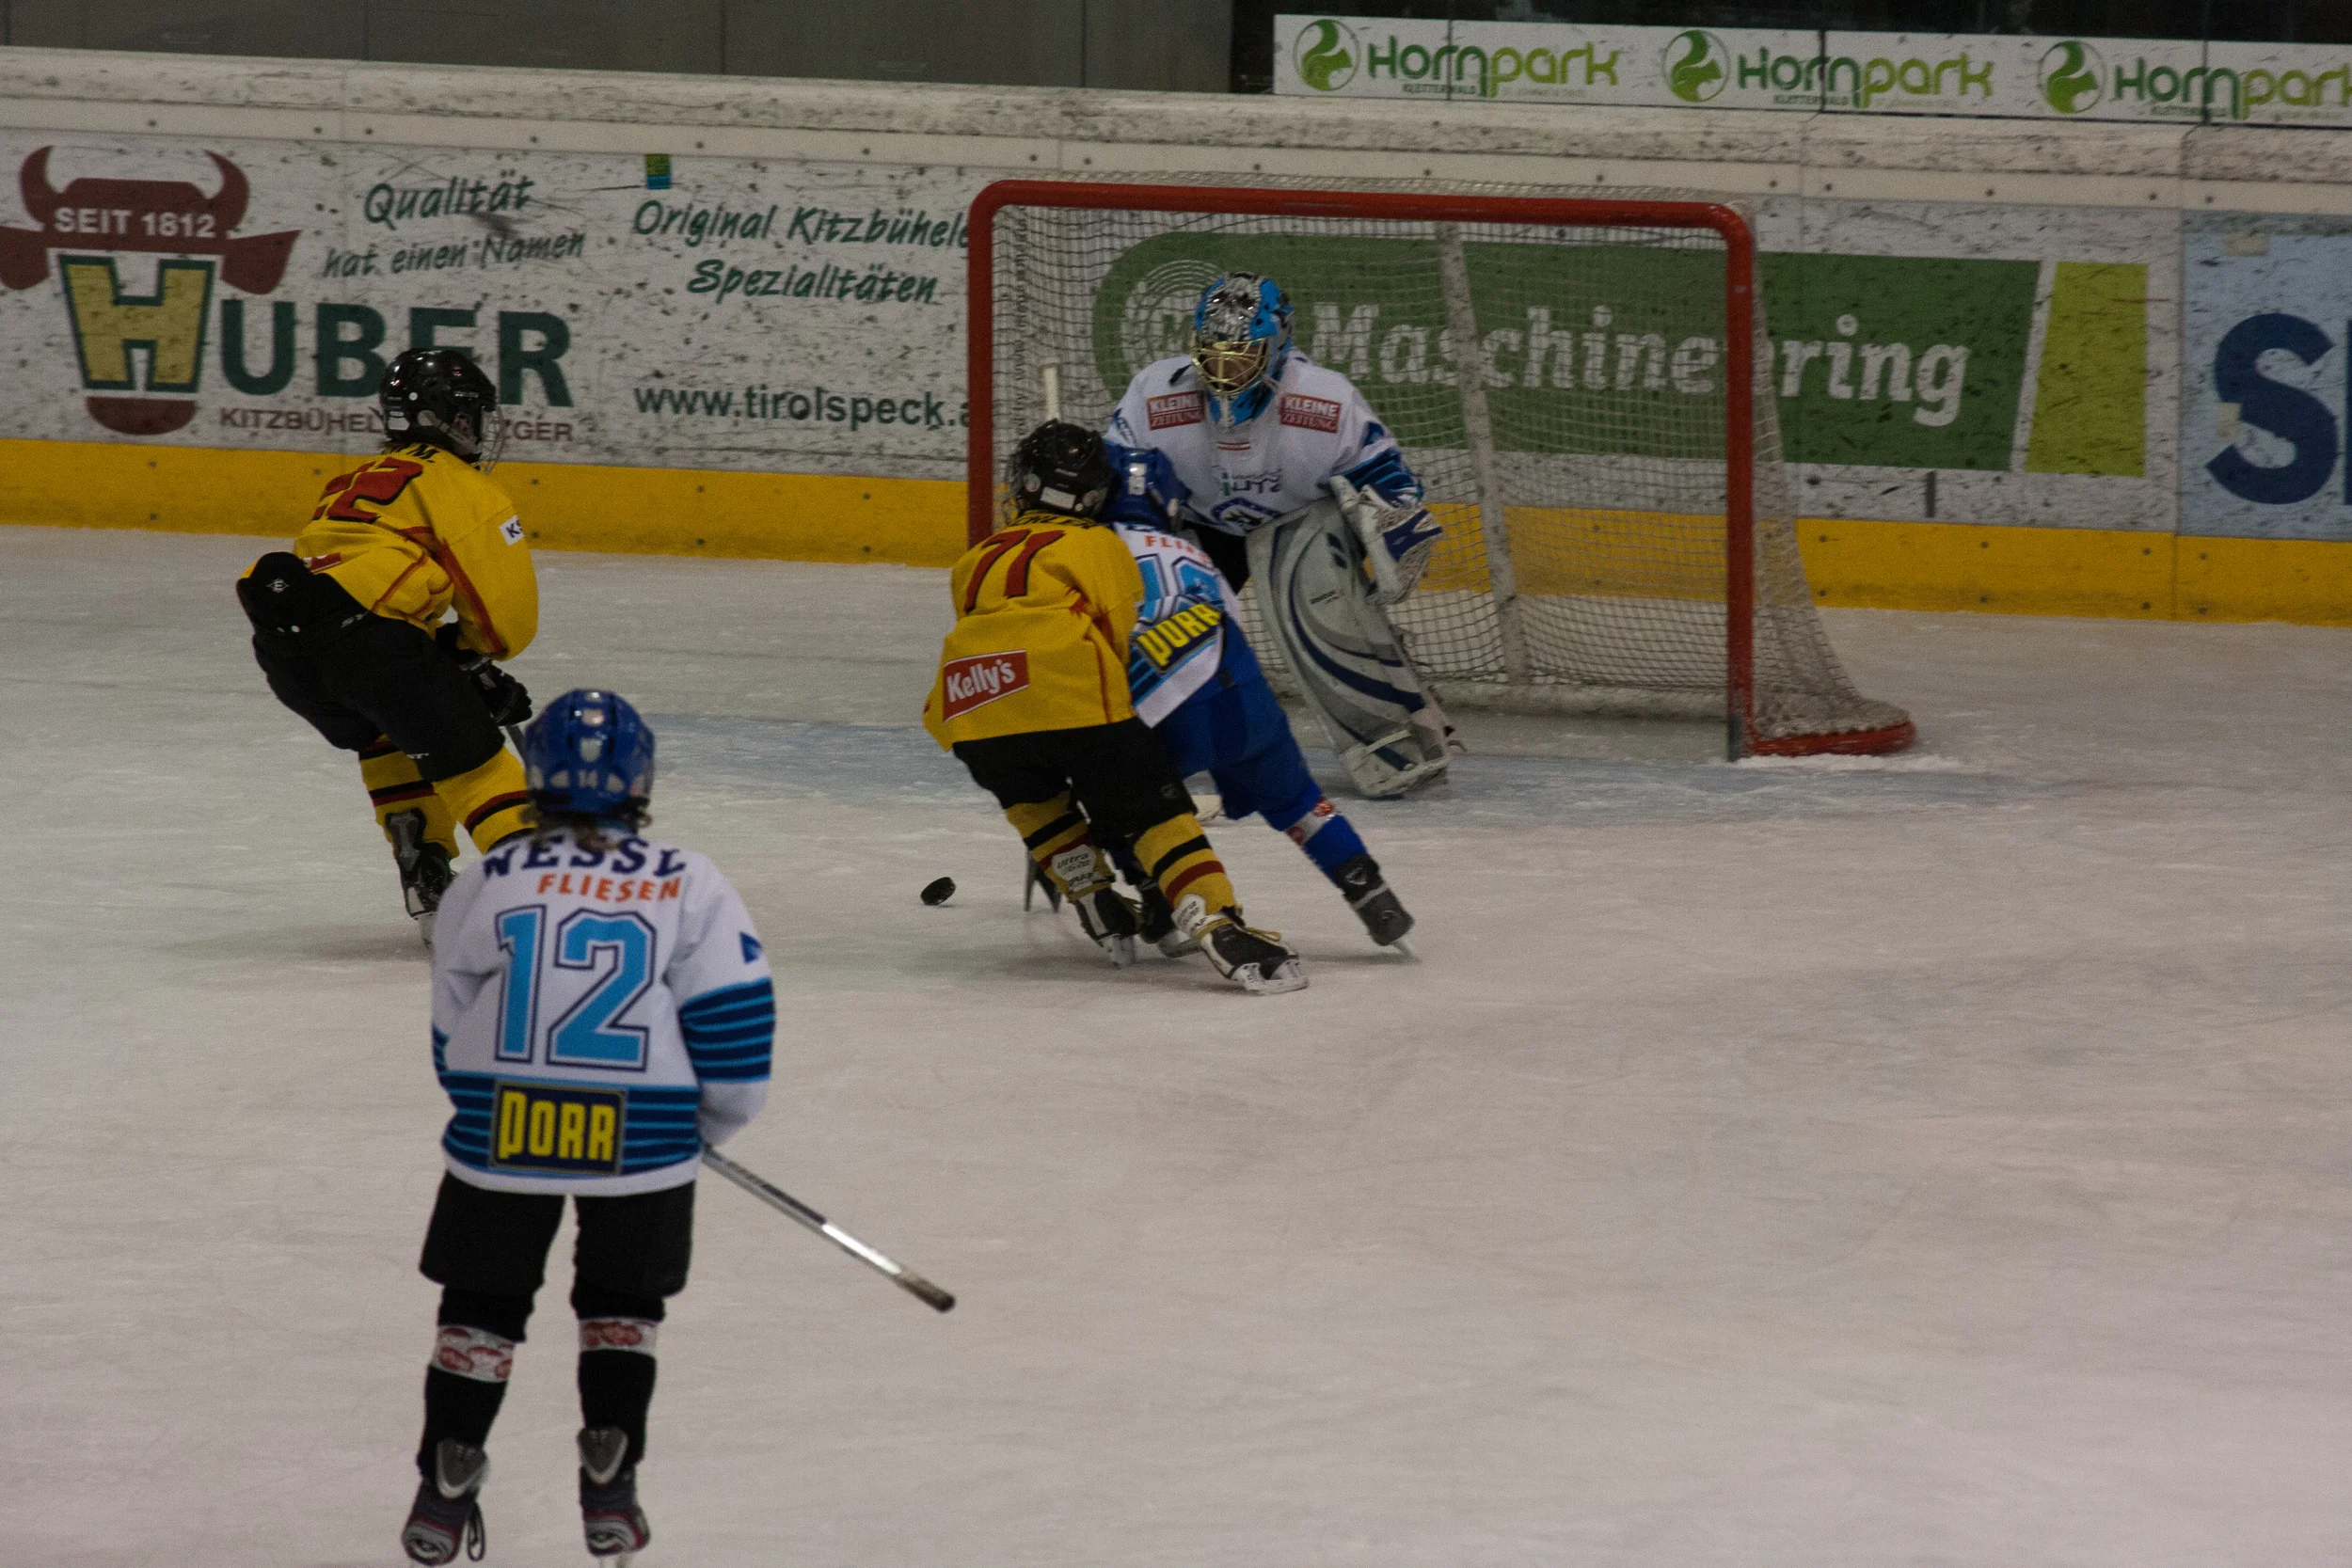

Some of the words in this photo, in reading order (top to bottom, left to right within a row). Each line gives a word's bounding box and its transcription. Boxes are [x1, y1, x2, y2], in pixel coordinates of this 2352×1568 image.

[1368, 35, 1618, 98] Hornpark
[1738, 46, 1994, 109] Hornpark
[363, 167, 536, 224] Qualität
[55, 206, 132, 235] SEIT
[142, 212, 218, 239] 1812
[633, 199, 777, 247] Original
[787, 206, 970, 249] Kitzbühele
[324, 247, 375, 279] hat
[391, 245, 467, 276] einen
[478, 231, 587, 266] Namen
[687, 259, 939, 304] Spezialitäten
[219, 405, 384, 436] KITZBÜHEL
[634, 384, 971, 432] www.tirolspeck.a
[1284, 395, 1339, 417] KLEINE
[2205, 312, 2352, 505] S
[963, 530, 1066, 615] 77
[946, 658, 1016, 705] Kelly's
[536, 873, 682, 903] FLIESEN
[495, 903, 657, 1073] 12
[498, 1090, 618, 1162] PORR
